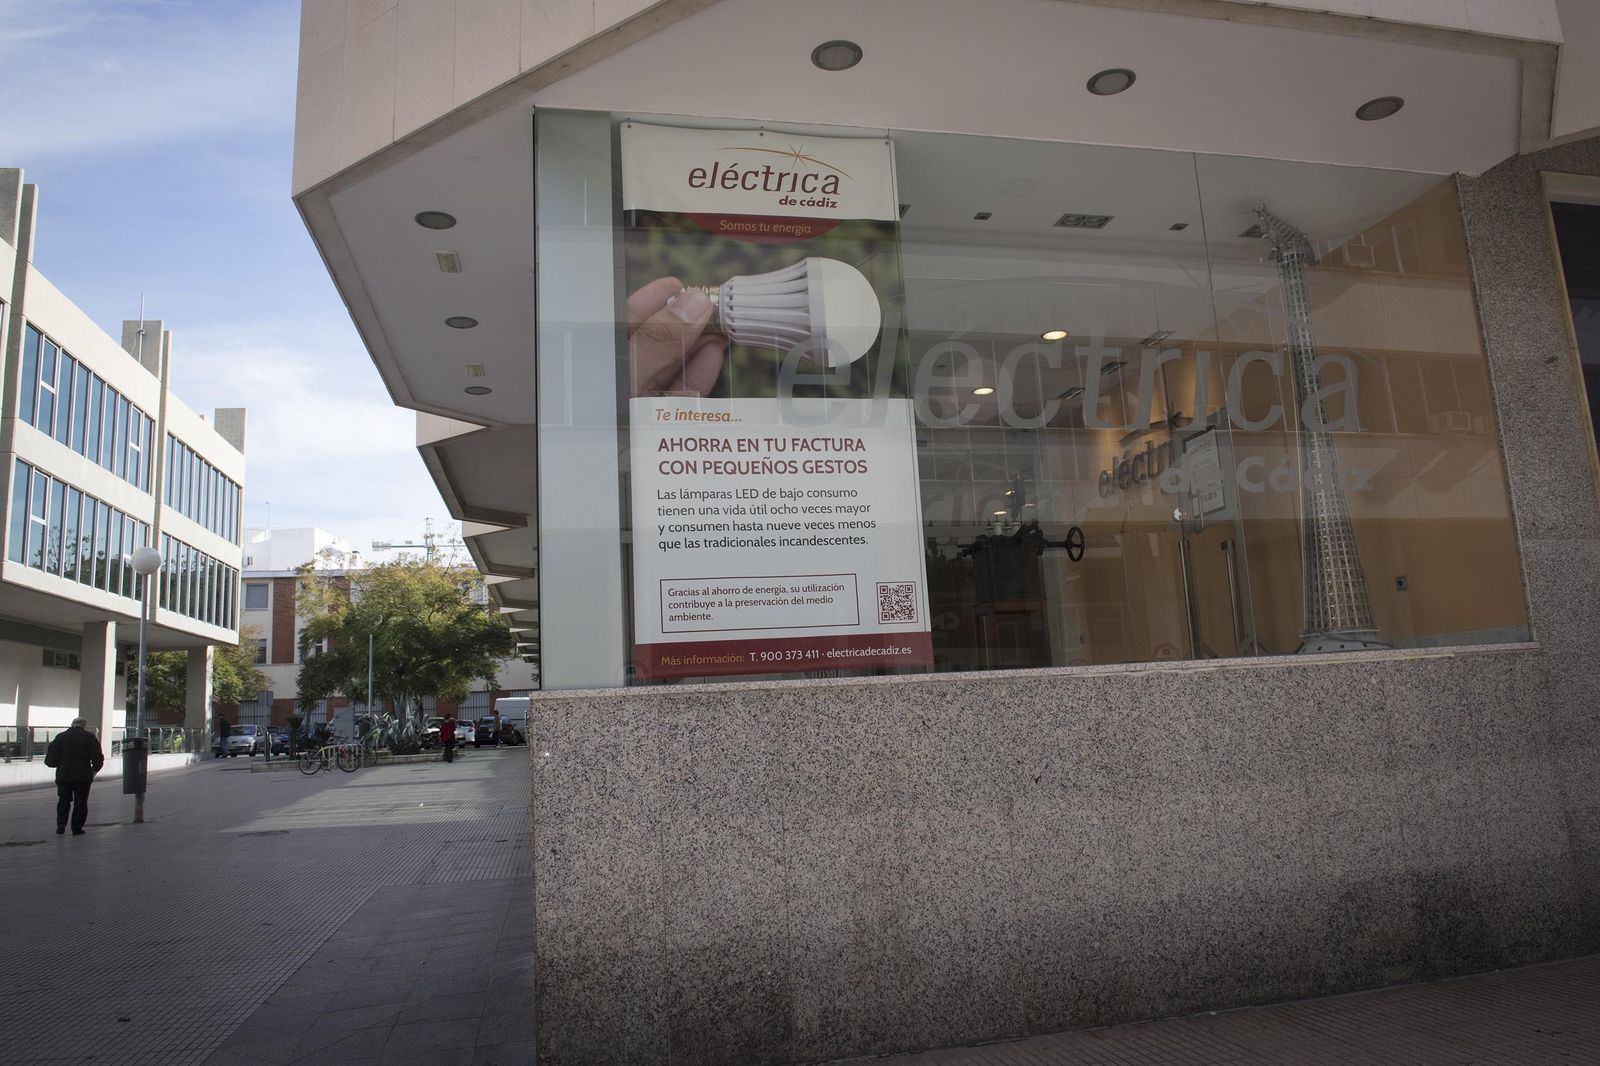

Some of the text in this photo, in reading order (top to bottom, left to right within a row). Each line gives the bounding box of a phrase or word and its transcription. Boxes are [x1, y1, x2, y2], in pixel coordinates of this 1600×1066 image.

[688, 162, 840, 195] eléctrica
[779, 196, 838, 208] de cádiz
[720, 220, 756, 232] Somos
[760, 223, 770, 232] tu
[777, 309, 1368, 432] eléctrica
[655, 408, 742, 422] Te interesa...
[658, 438, 866, 452] AHORRA EN TU FACTURA
[658, 457, 868, 475] CON PEQUEÑOS GESTOS
[657, 488, 858, 502] Las lámparas LED de bajo consumo
[657, 504, 871, 516] tienen una vida útil ocho veces mayor
[658, 520, 876, 535] y consumen hasta nueve veces menos
[658, 535, 869, 552] que las tradicionales incandescentes.
[668, 588, 700, 597] Gracias
[701, 587, 710, 596] al
[712, 586, 741, 595] ahorro
[742, 585, 754, 595] de
[790, 585, 800, 594] su
[802, 583, 845, 593] utilización
[668, 598, 716, 611] contribuye
[725, 597, 733, 608] la
[735, 596, 789, 608] preservación
[791, 595, 805, 605] del
[806, 595, 833, 604] medio
[668, 611, 714, 622] ambiente.
[661, 645, 912, 666] Más información: T. 900 373 411 electricadecadiz.es
